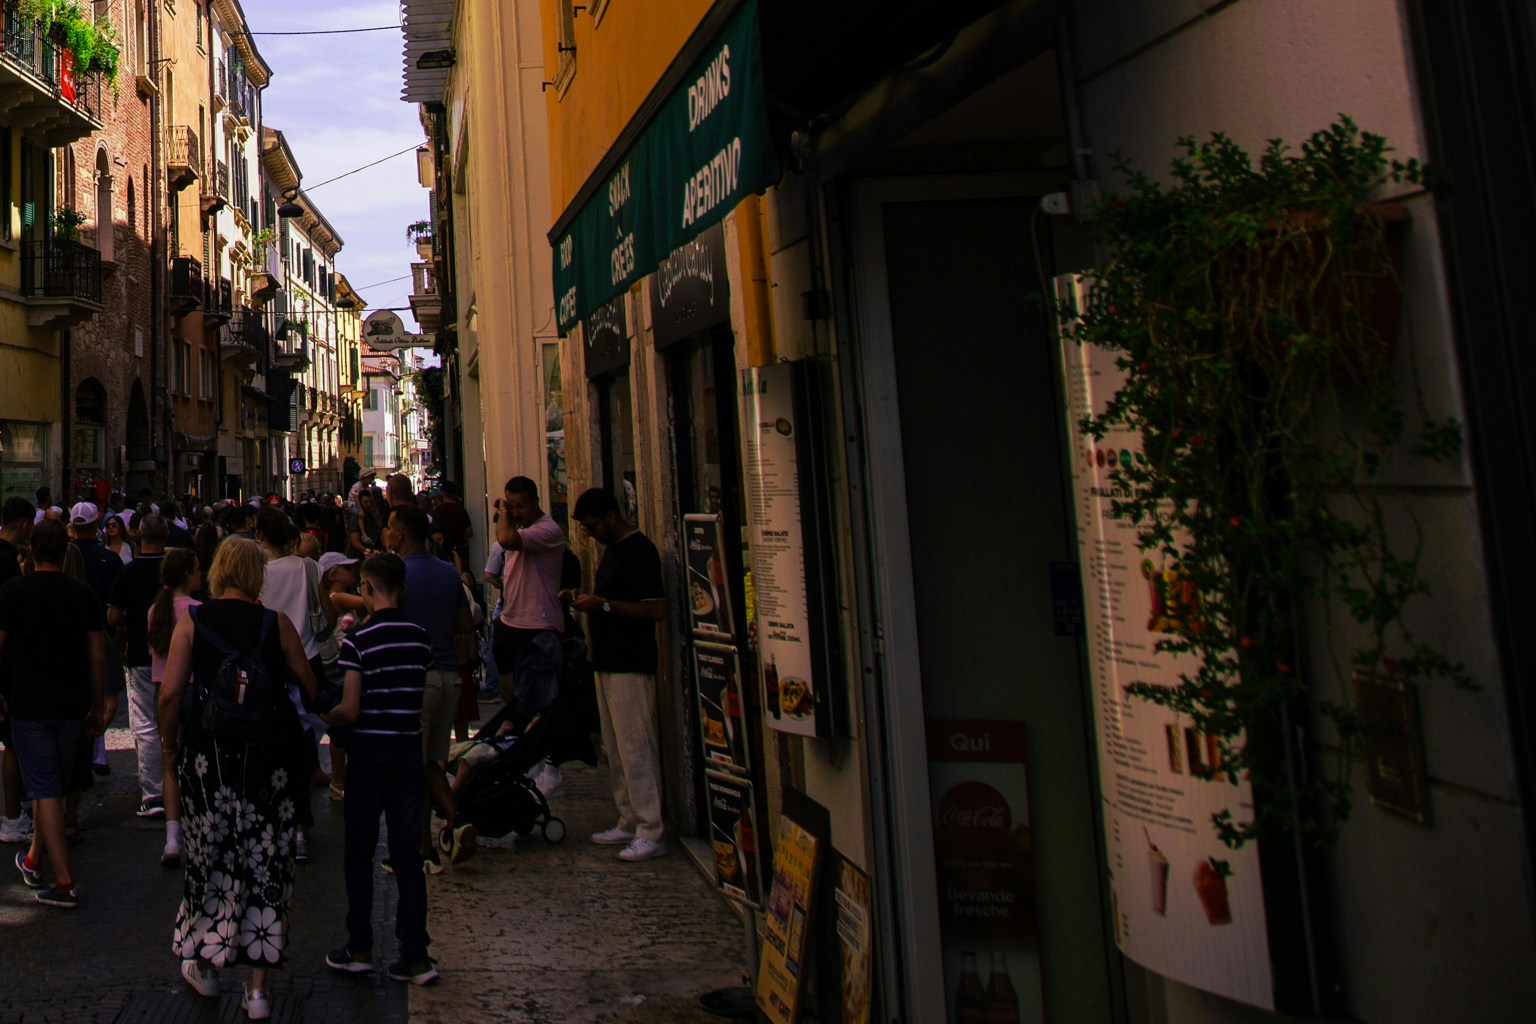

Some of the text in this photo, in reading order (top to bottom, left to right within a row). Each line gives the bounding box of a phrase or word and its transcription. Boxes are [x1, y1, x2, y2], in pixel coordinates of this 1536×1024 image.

[688, 43, 731, 133] DRINKS
[681, 135, 742, 230] APERITIVO
[949, 731, 991, 752] Qui
[947, 887, 1015, 904] Bevande
[952, 901, 1009, 918] fresche
